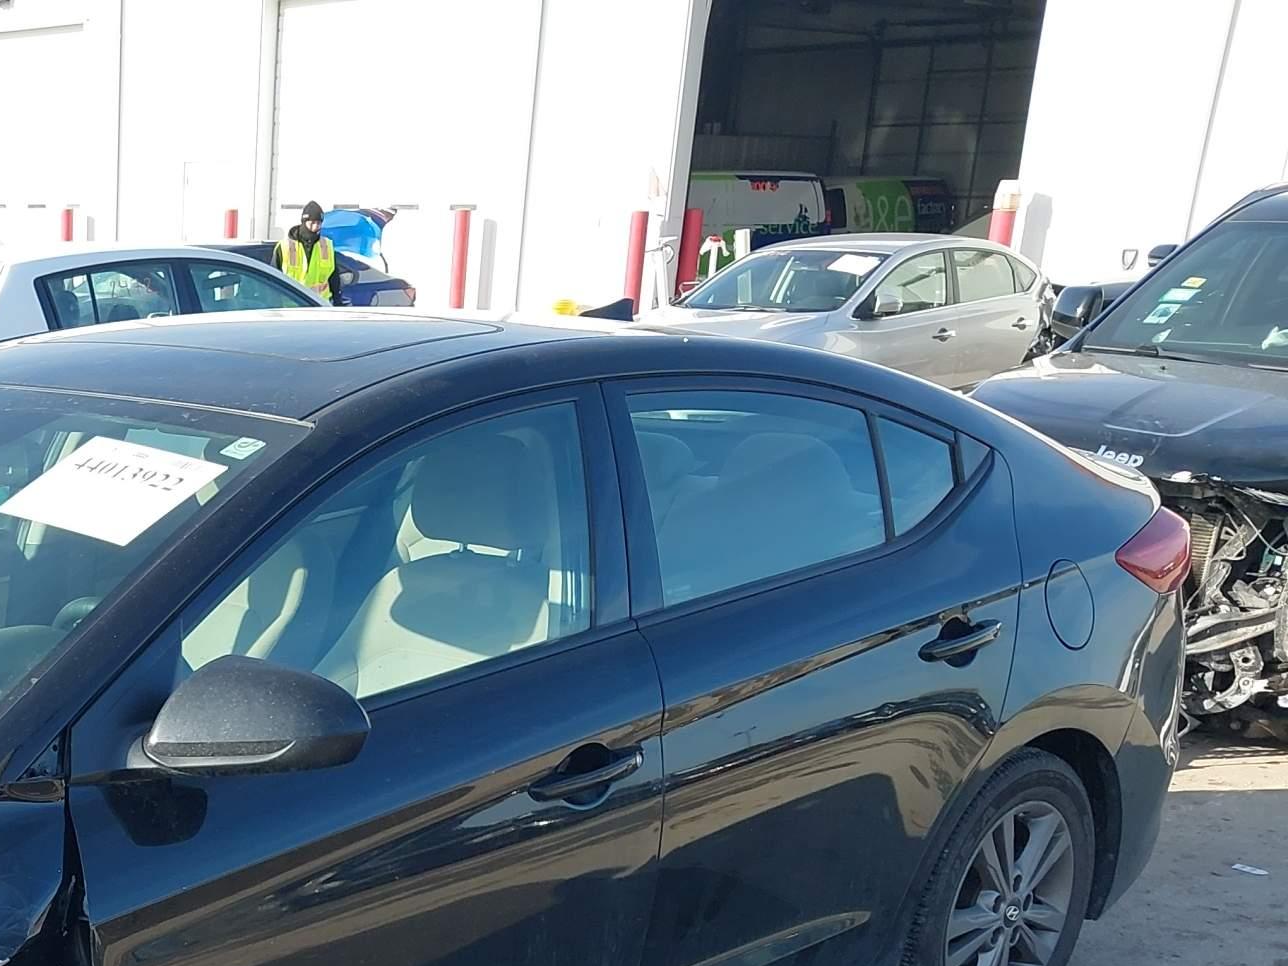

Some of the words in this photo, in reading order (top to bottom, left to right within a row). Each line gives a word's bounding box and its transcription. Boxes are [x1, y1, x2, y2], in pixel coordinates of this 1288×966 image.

[759, 219, 817, 235] service
[1096, 444, 1144, 468] Jeep
[74, 457, 185, 492] 44013922
